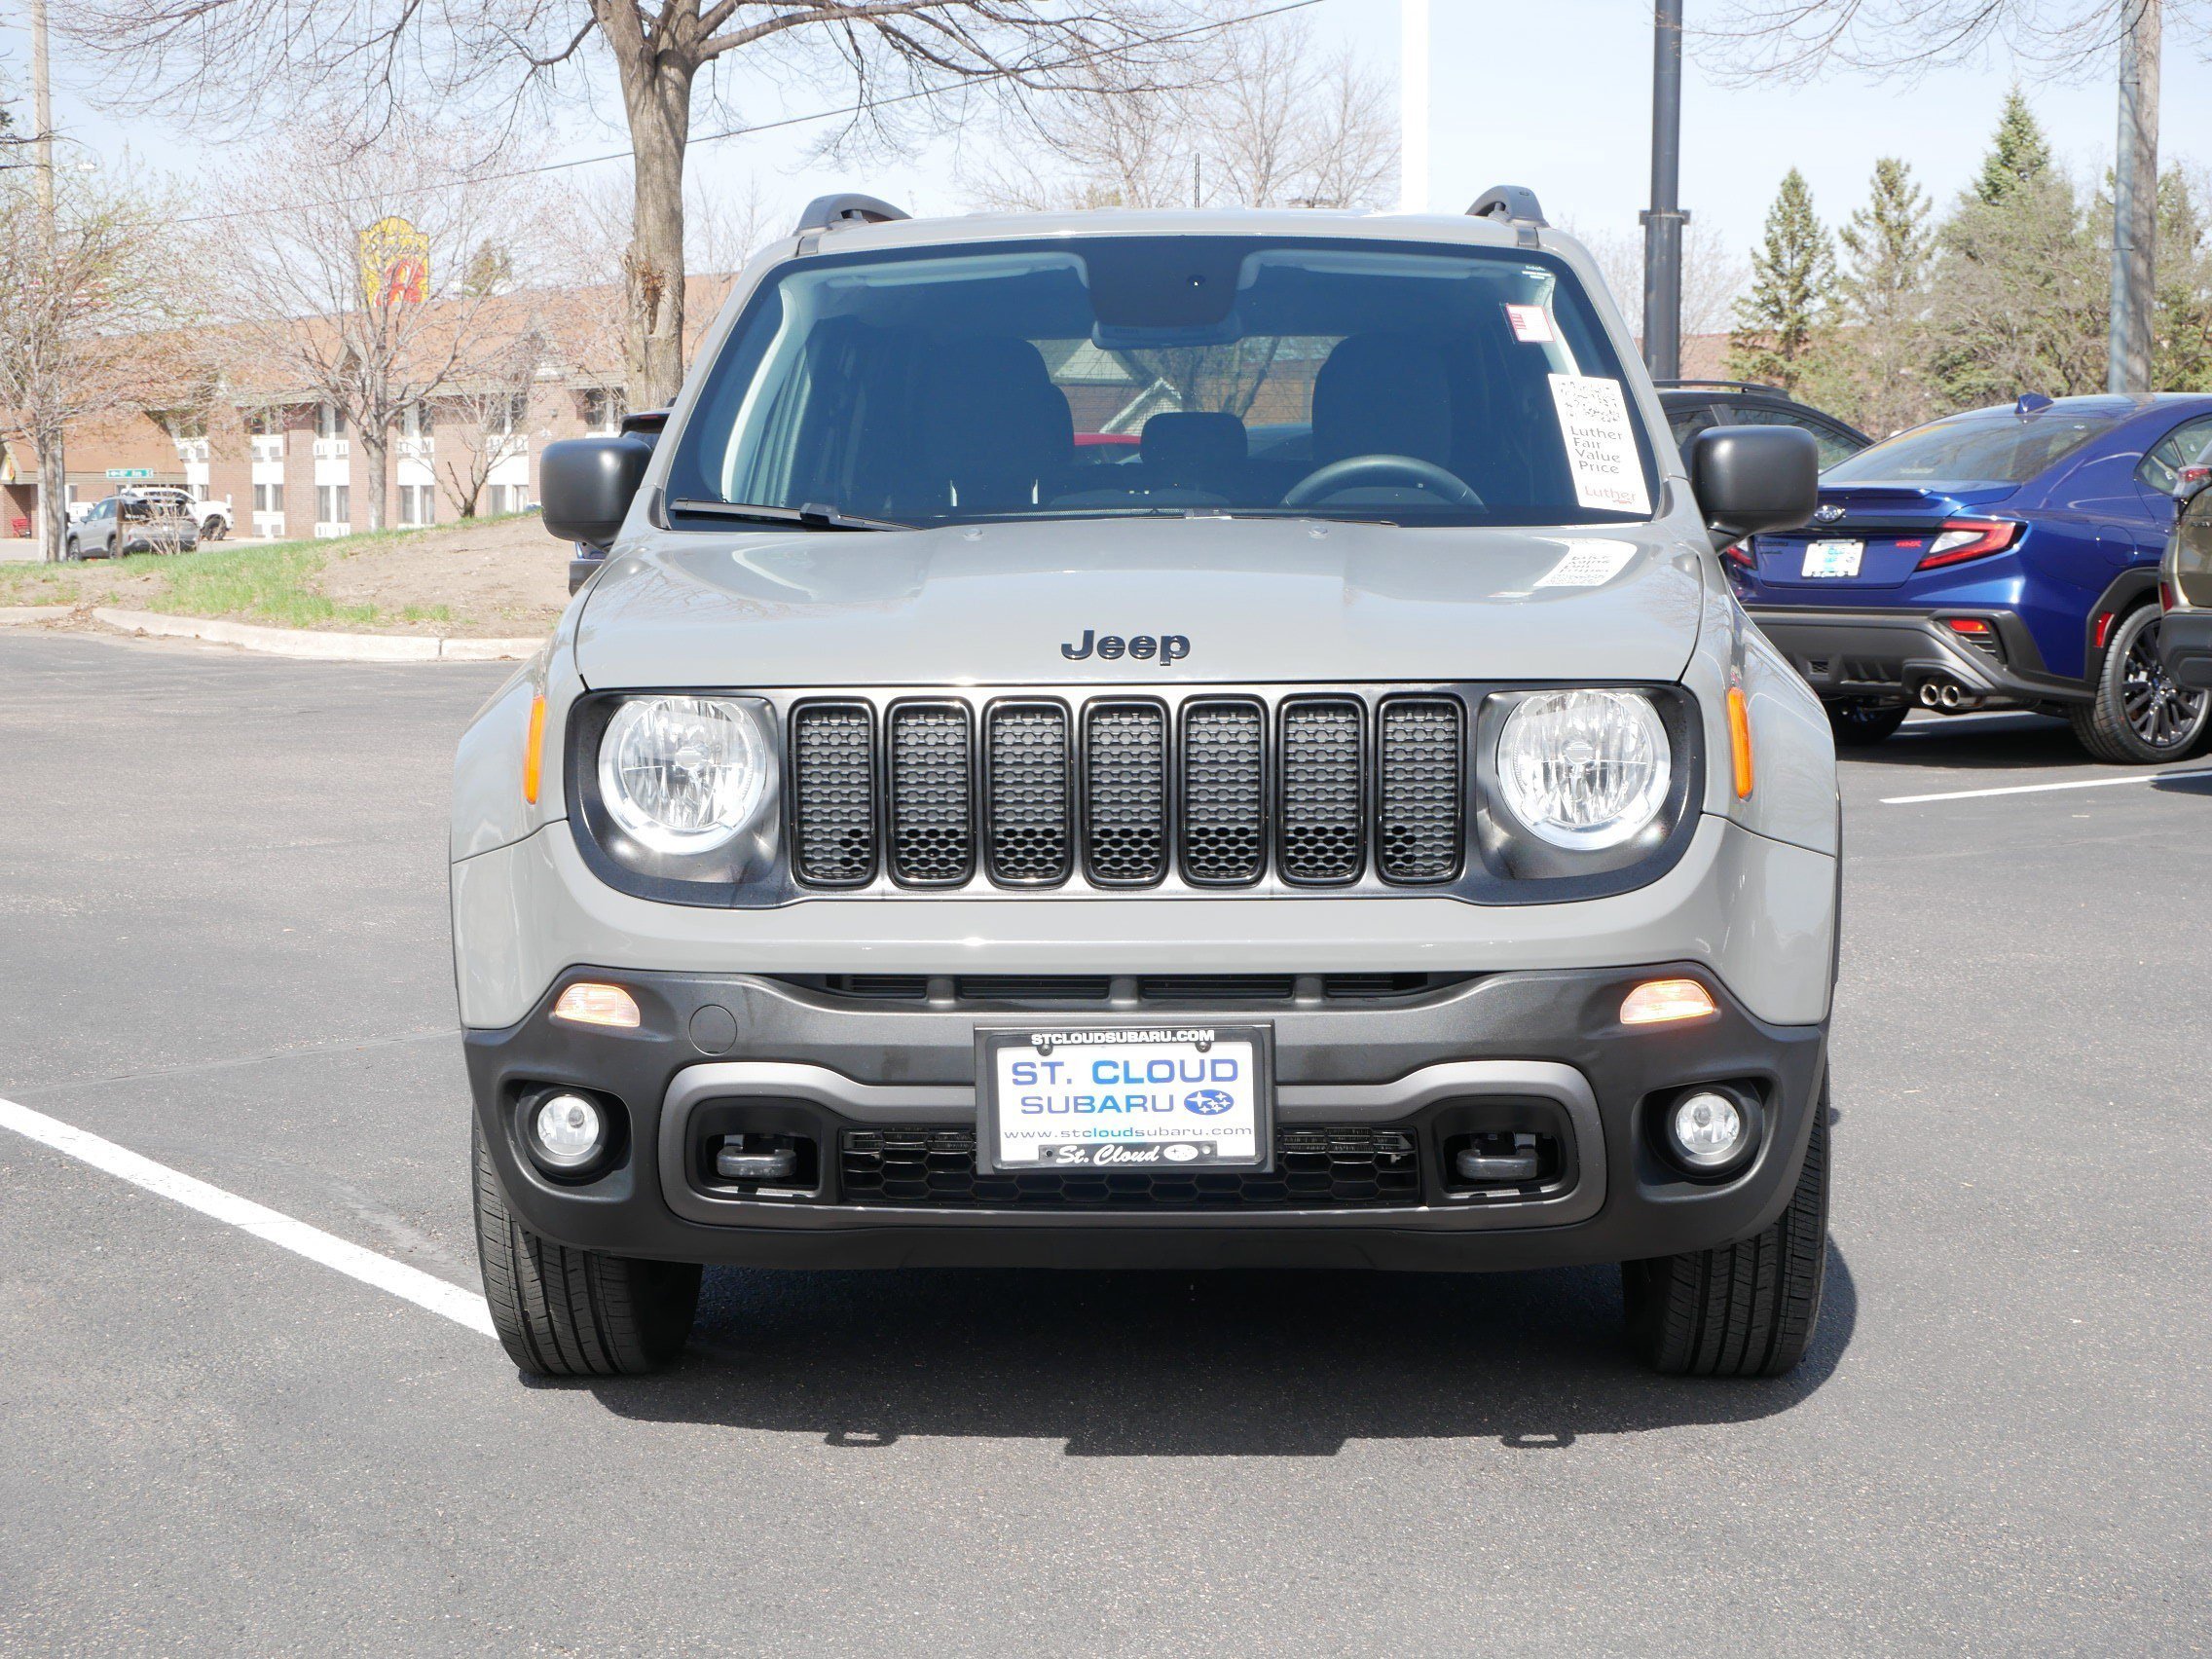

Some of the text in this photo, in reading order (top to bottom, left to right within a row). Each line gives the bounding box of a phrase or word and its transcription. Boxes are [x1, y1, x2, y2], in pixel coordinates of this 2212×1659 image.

[1570, 425, 1623, 440] Luther
[1573, 437, 1602, 449] Fair
[1574, 448, 1621, 463] Value
[1578, 460, 1620, 474] Price
[1584, 485, 1637, 502] Luther
[1061, 630, 1191, 666] Jeep
[1031, 1029, 1215, 1046] STCLOUDSUBARU.COM
[1012, 1058, 1239, 1086] ST. CLOUD
[1021, 1093, 1175, 1115] SUBARU
[1004, 1126, 1253, 1139] www.stcloudsubaru.com
[1056, 1144, 1161, 1165] St. Cloud
